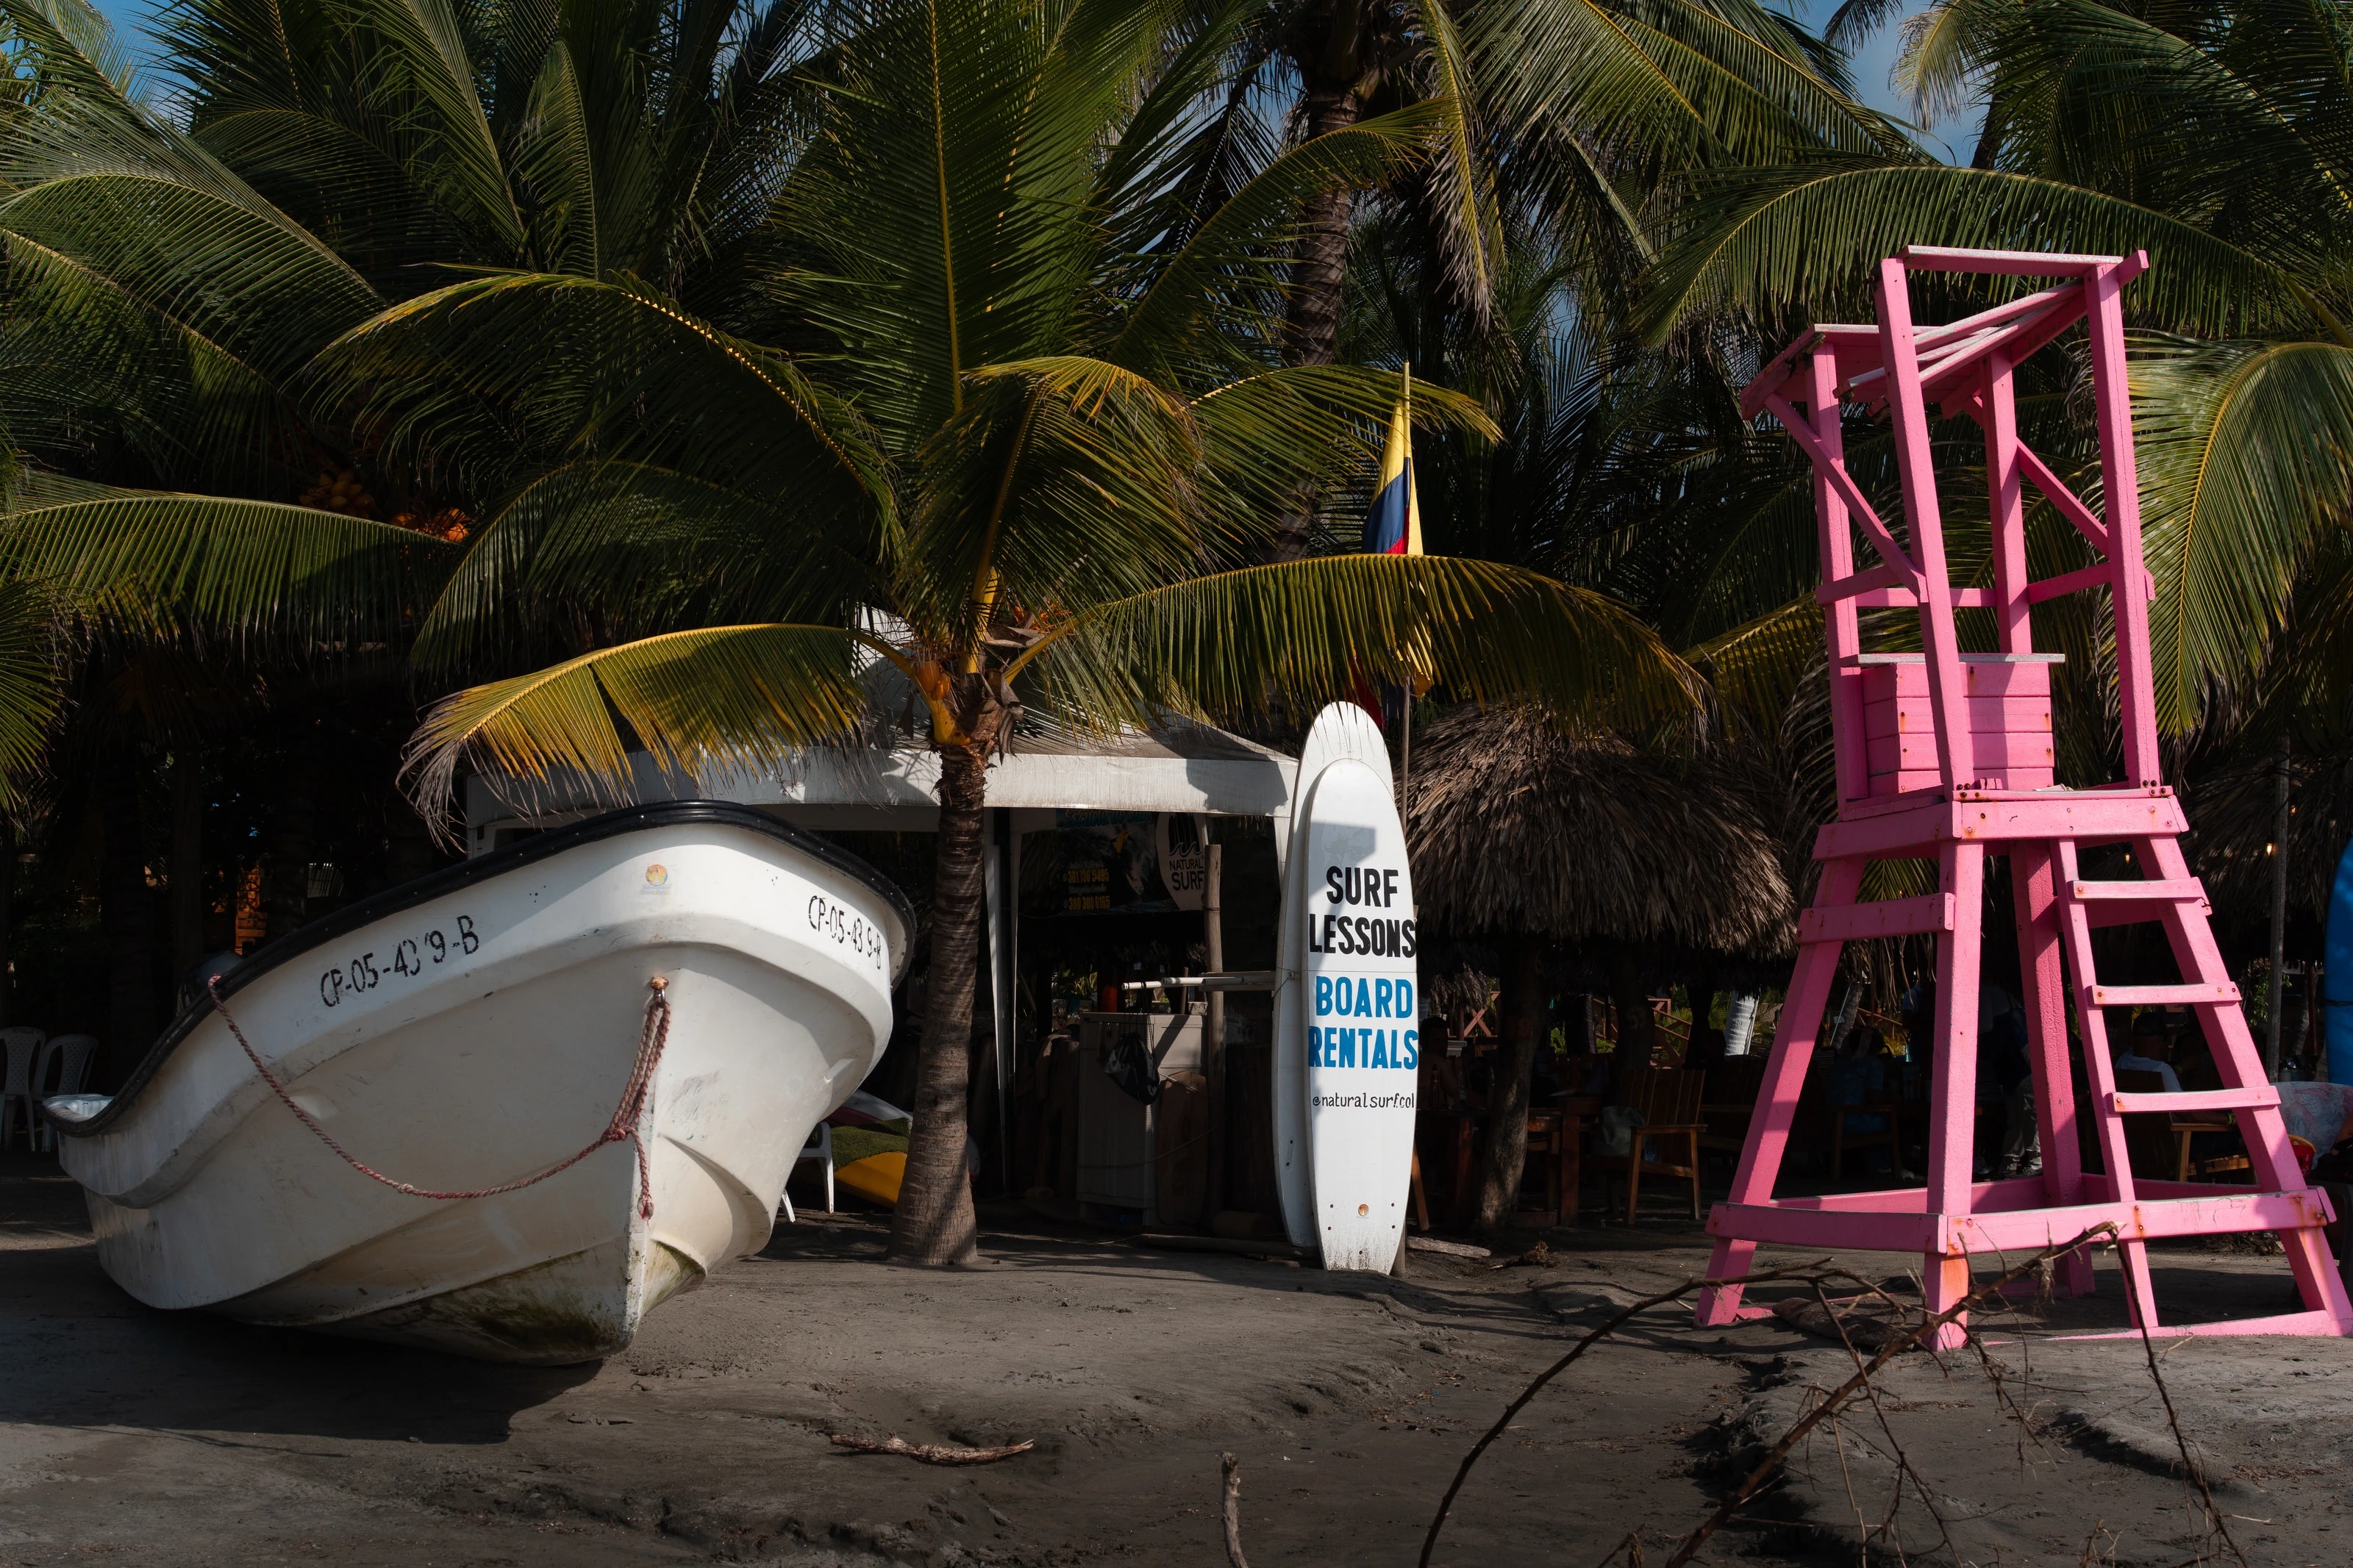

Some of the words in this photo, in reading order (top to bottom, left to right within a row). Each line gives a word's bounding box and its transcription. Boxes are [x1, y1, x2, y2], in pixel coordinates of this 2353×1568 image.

[1169, 859, 1204, 871] NATURAL
[1171, 871, 1204, 891] SURF
[1326, 866, 1399, 908] SURF
[1309, 914, 1416, 958] LESSONS
[1315, 975, 1413, 1019] BOARD
[1309, 1025, 1418, 1070] RENTALS
